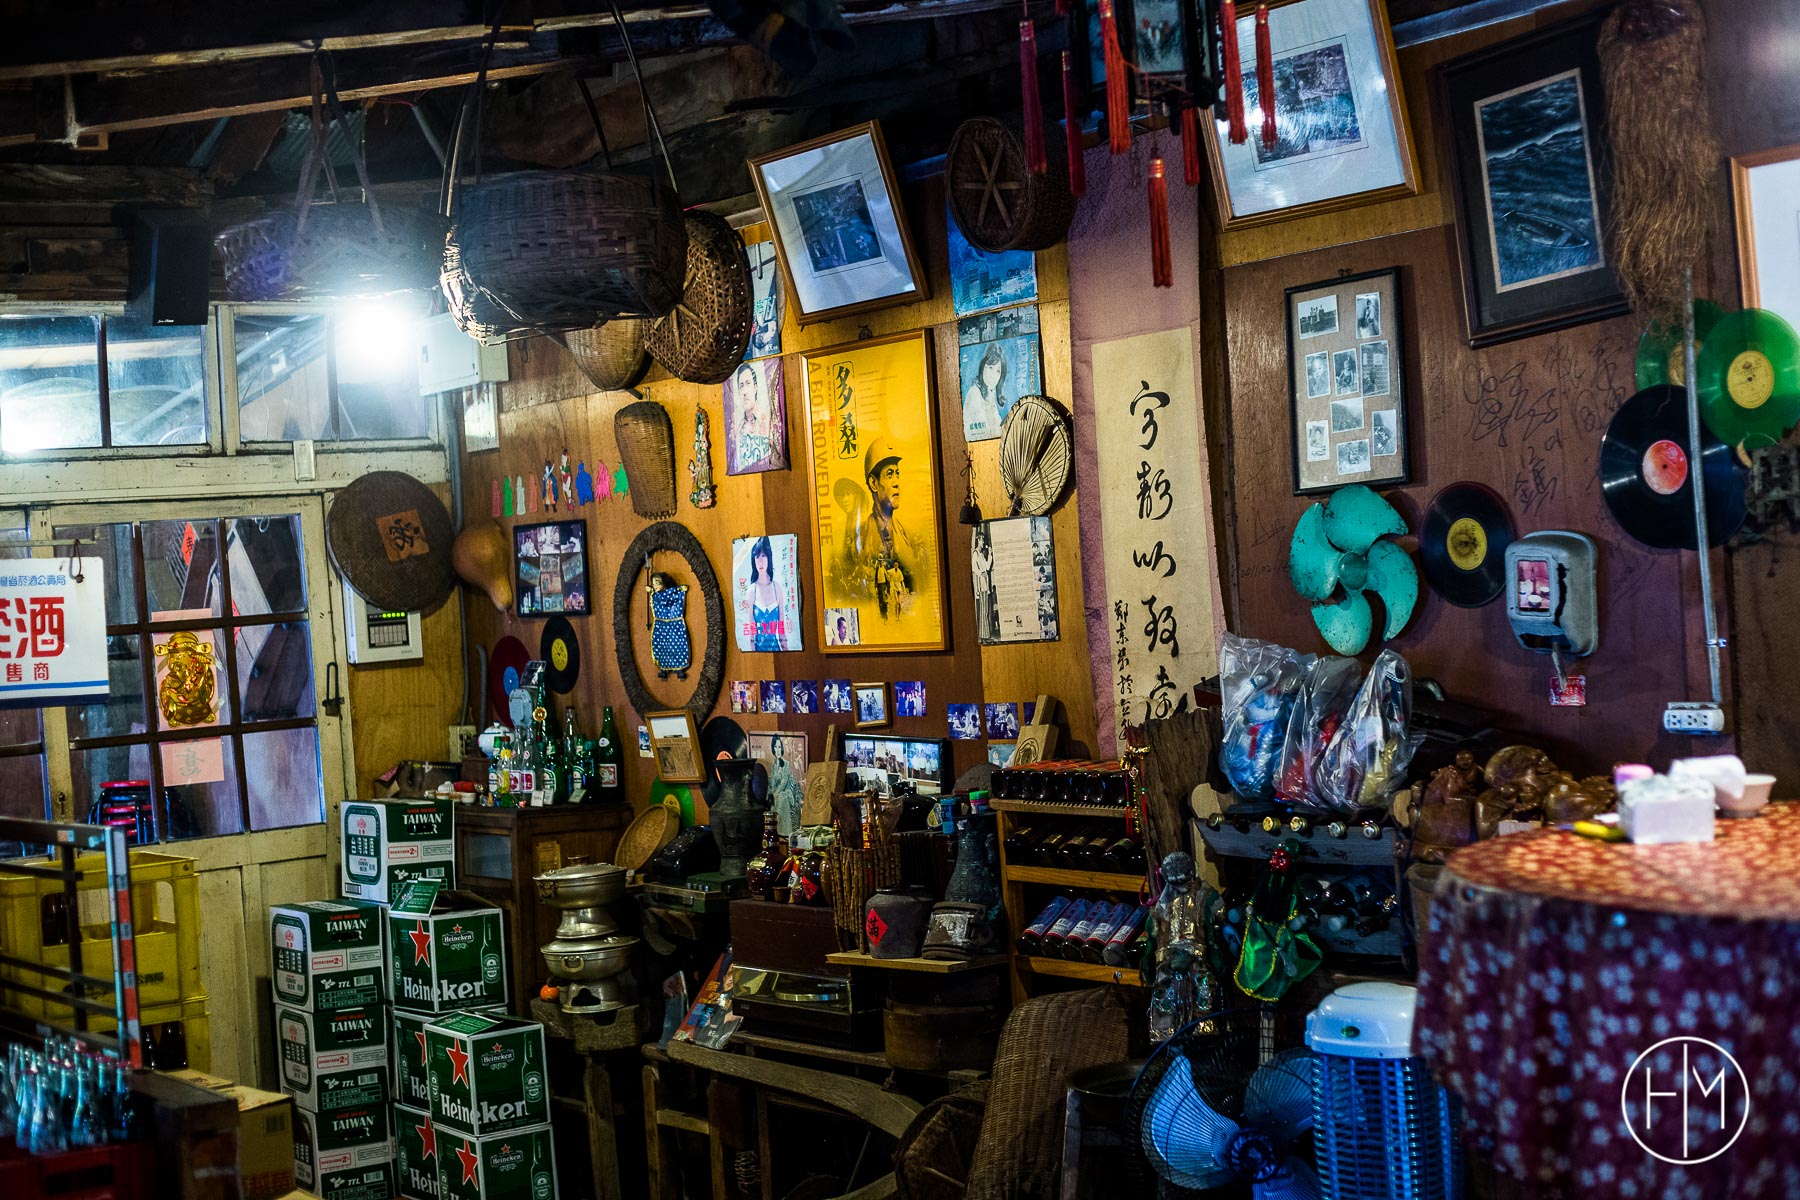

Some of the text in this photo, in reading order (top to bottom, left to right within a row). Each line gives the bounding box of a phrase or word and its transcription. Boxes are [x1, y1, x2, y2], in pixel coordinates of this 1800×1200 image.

[836, 365, 857, 455] 多桑
[818, 506, 834, 547] LIFE
[0, 596, 65, 659] 酒
[402, 813, 443, 825] TAIWAN
[325, 919, 367, 932] TAIWAN
[867, 916, 880, 938] 滿
[444, 934, 472, 943] Heineken
[403, 976, 487, 1002] Heineken
[330, 1018, 373, 1033] TAIWAN
[483, 1051, 513, 1063] Heineken
[440, 1093, 530, 1125] Heineken
[332, 1115, 374, 1131] TAIWAN
[492, 1153, 522, 1164] Heineken
